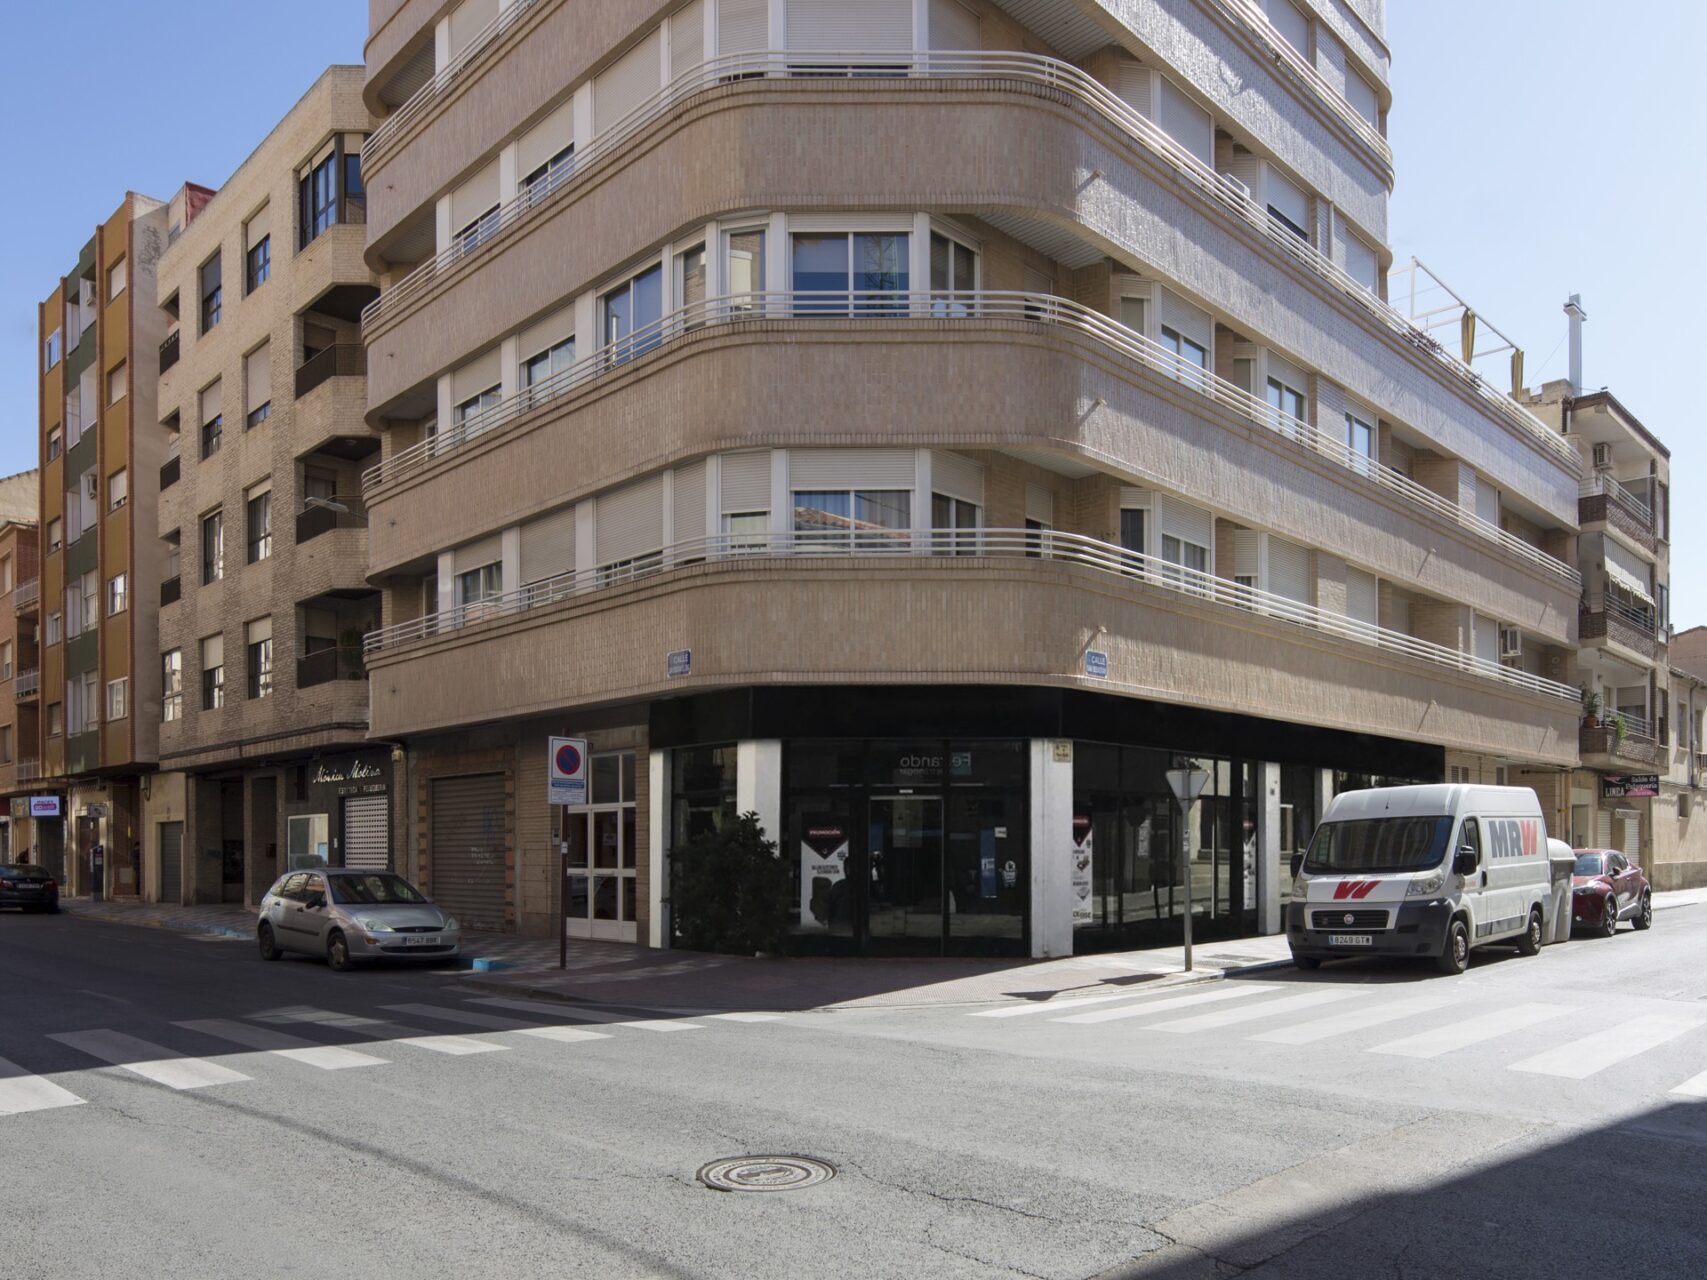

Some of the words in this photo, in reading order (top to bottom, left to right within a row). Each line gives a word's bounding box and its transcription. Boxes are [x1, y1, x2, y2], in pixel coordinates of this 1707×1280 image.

[673, 654, 688, 664] CALLE
[1091, 655, 1105, 665] CALLE
[1488, 820, 1537, 858] MRW
[1334, 936, 1354, 945] 8249
